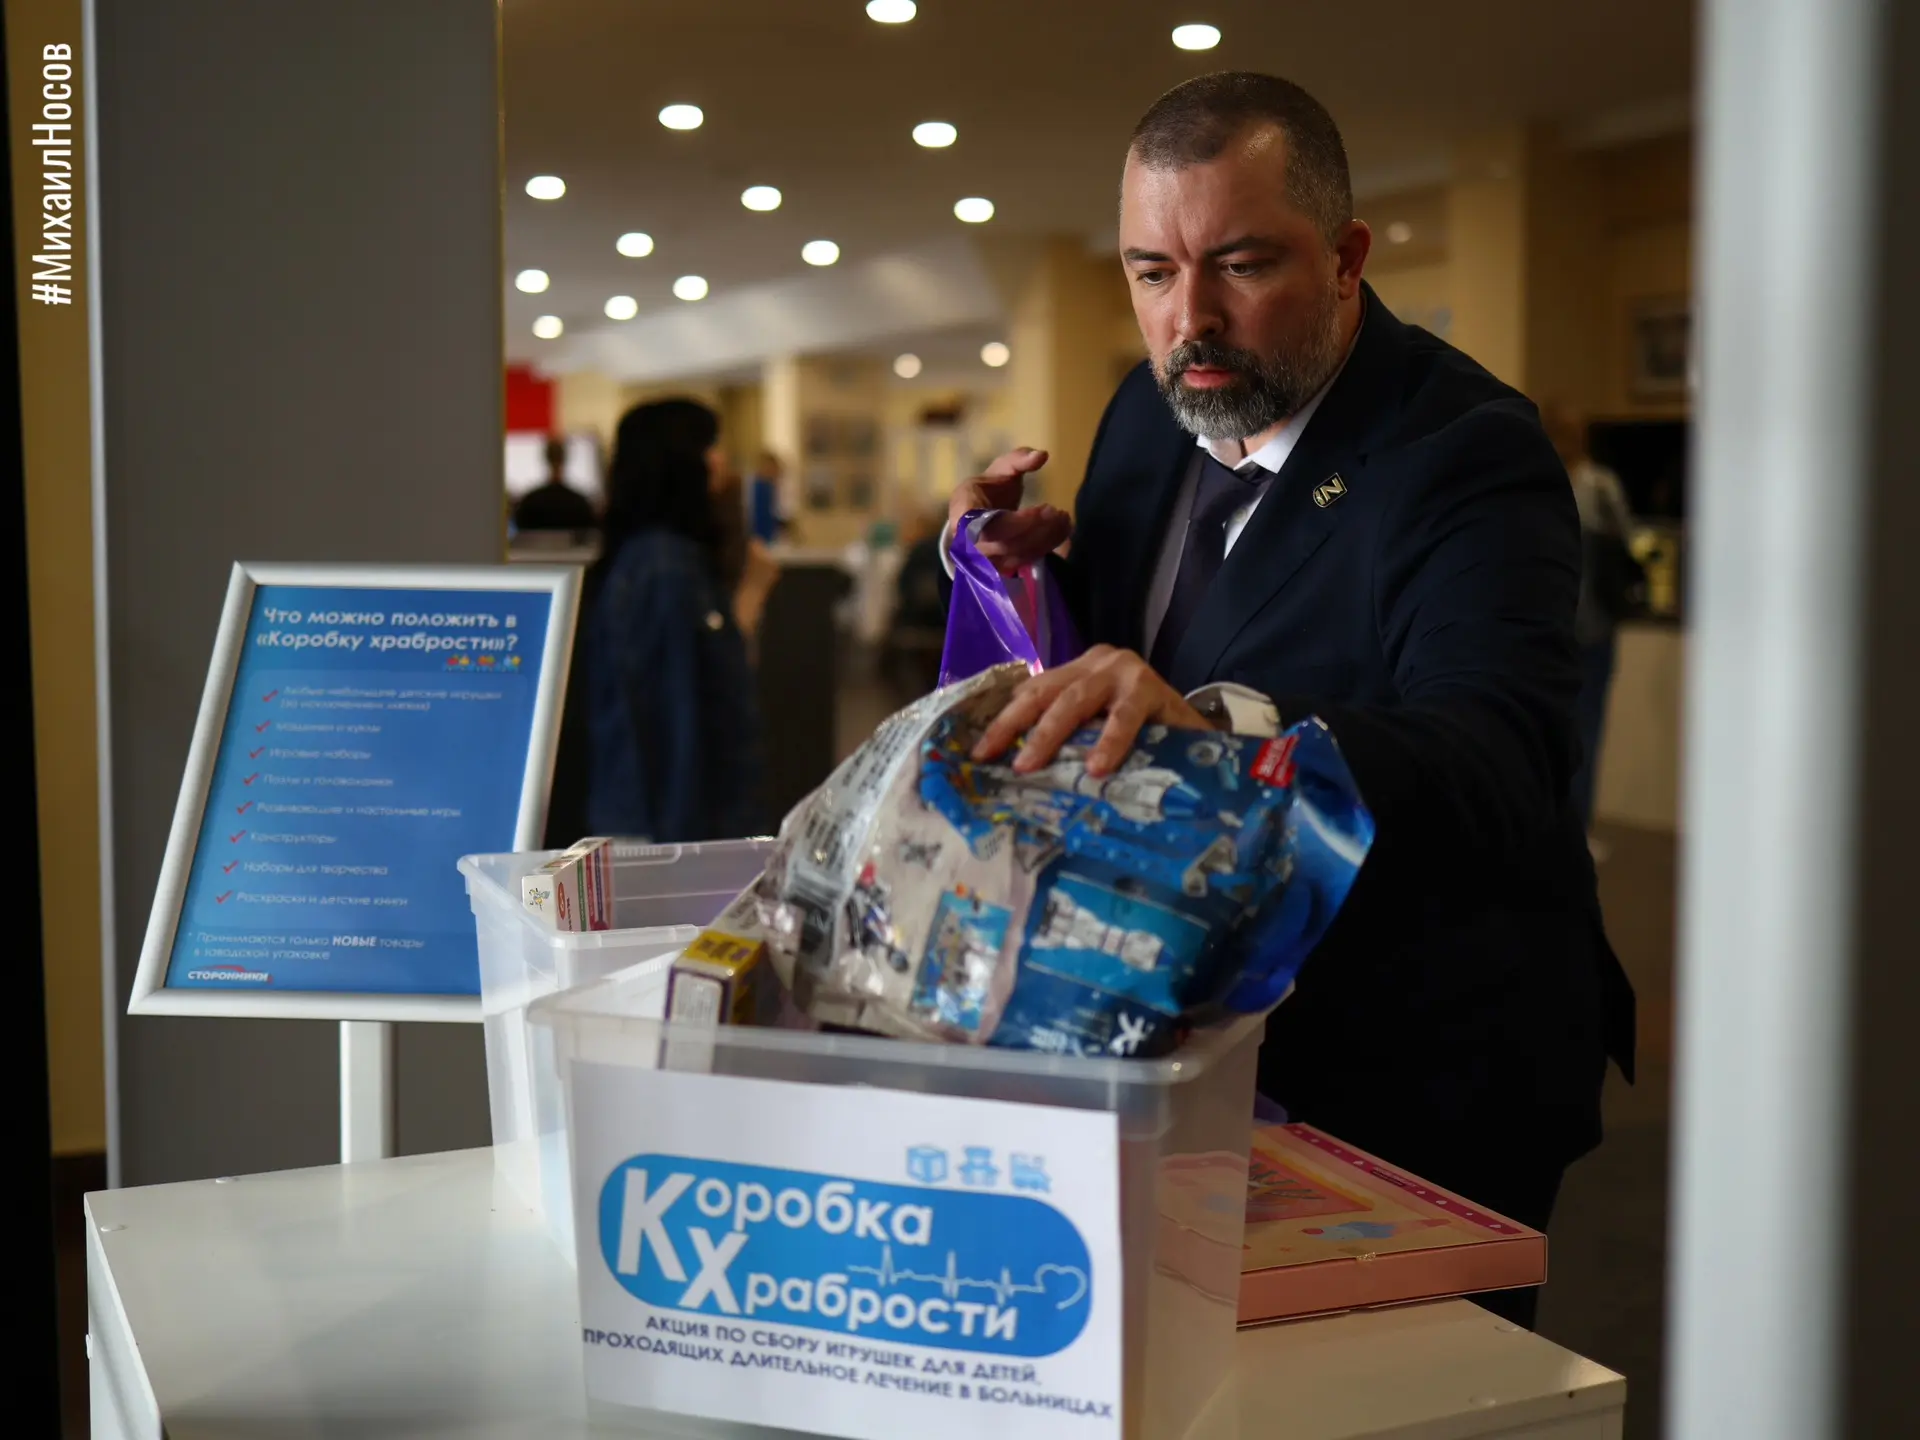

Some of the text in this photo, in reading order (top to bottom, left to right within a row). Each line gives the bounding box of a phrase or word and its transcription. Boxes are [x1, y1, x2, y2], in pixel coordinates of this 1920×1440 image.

[264, 608, 517, 628] Что можно положить в
[257, 630, 519, 652] «Коробку храбрости»?
[357, 806, 429, 816] настольные
[431, 807, 461, 818] игры
[251, 832, 337, 844] Конструкторы
[244, 862, 388, 876] Наборы для творчества
[236, 893, 306, 904] Раскраски
[308, 896, 317, 904] и
[319, 895, 370, 906] детские
[197, 932, 424, 949] Принимаются только НОВЫЕ товары
[204, 947, 269, 958] заводской
[272, 949, 330, 961] упаковке
[188, 970, 268, 982] СТОРОННИКИ
[616, 1167, 934, 1283] Коробка
[677, 1226, 1019, 1341] Храбрости
[645, 1314, 710, 1338] АКЦИЯ
[715, 1324, 747, 1344] ПО
[753, 1327, 818, 1355] СБОРУ
[826, 1341, 915, 1370] ИГРУШЕК
[921, 1355, 966, 1376] ДЛЯ
[583, 1327, 1114, 1420] ПРОХОДЯЩИХ ДЛИТЕЛЬНОЕ ЛЕЧЕНИЕ В БОЛЬНИЦАХ
